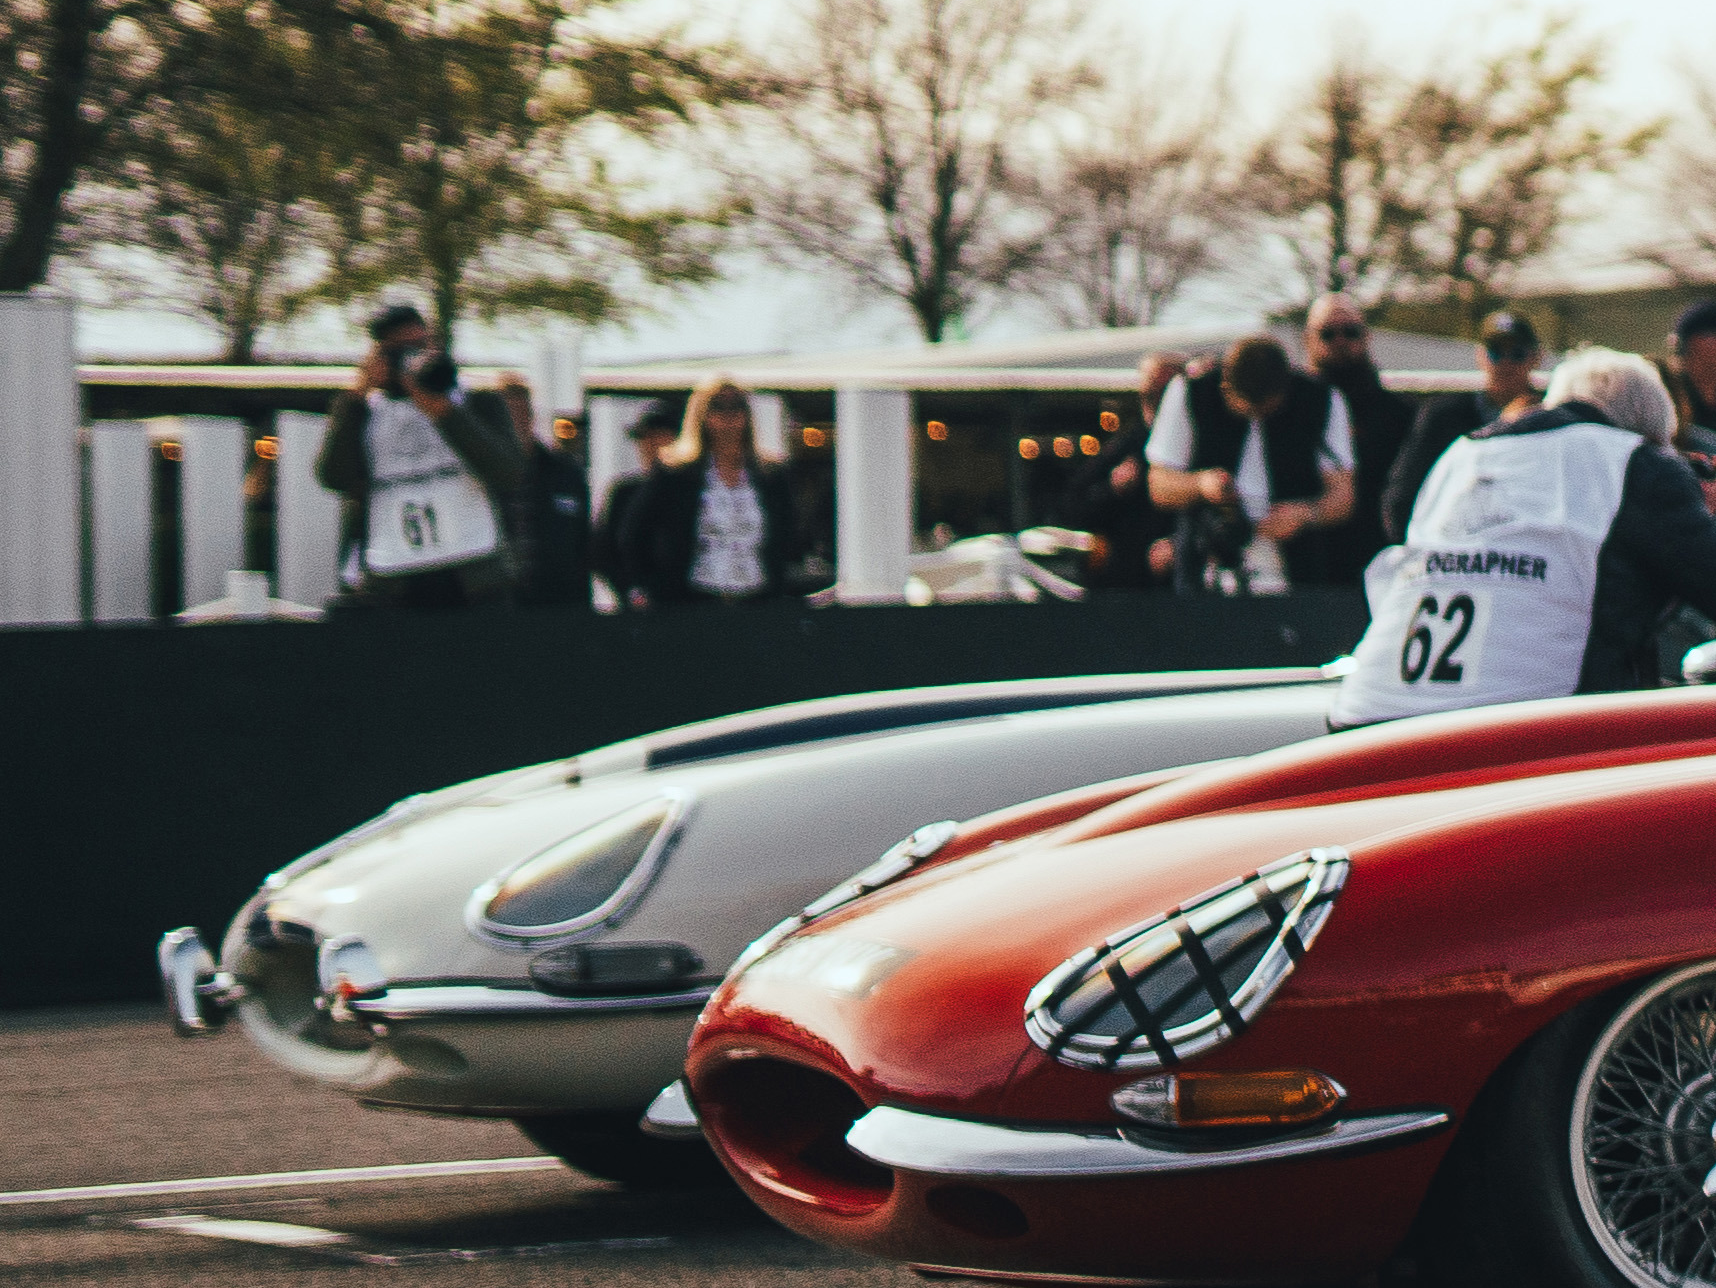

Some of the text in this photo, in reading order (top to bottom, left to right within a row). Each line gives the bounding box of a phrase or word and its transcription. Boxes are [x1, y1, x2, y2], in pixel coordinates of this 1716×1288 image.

[402, 501, 440, 548] 61
[1424, 549, 1548, 581] OGRAPHER
[1400, 593, 1476, 684] 62
